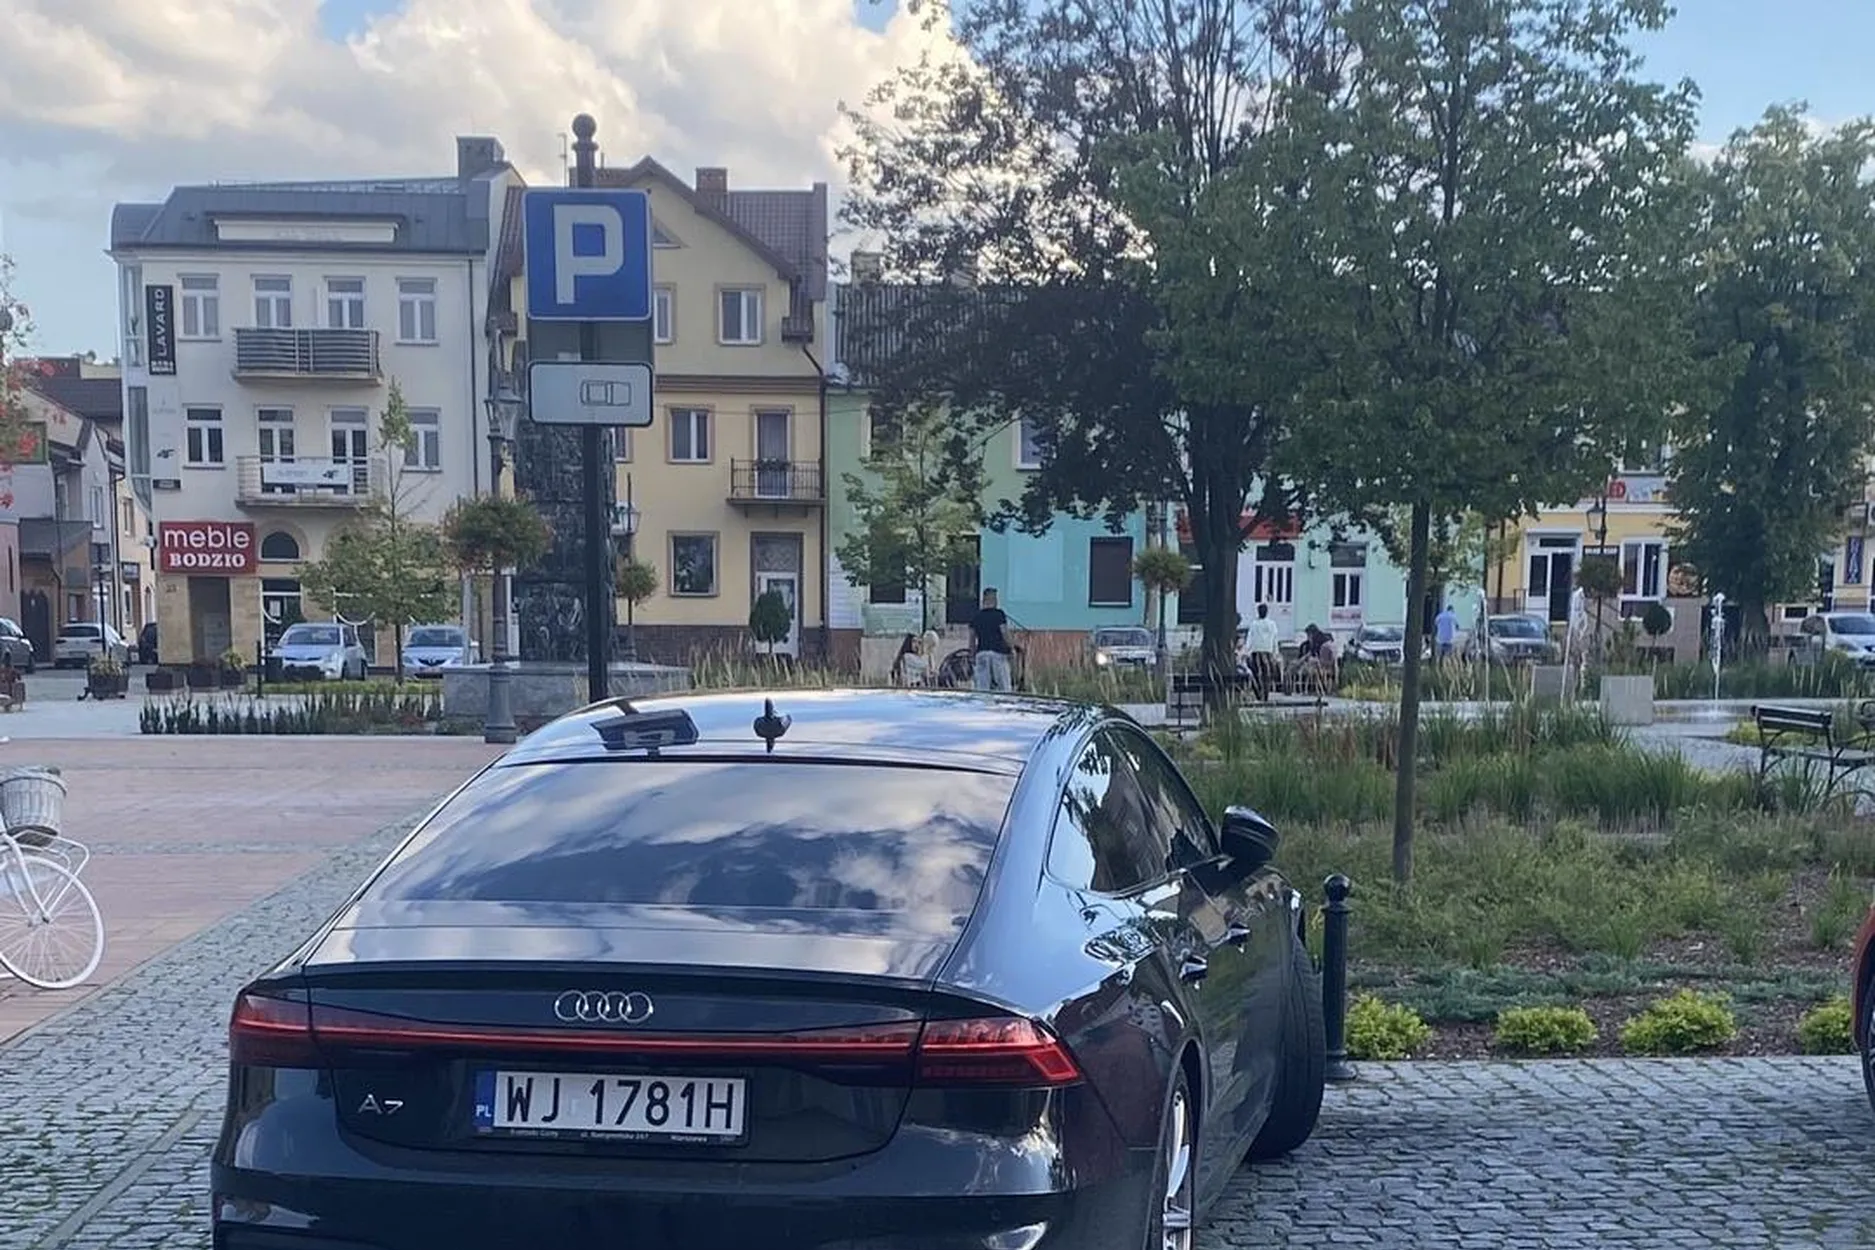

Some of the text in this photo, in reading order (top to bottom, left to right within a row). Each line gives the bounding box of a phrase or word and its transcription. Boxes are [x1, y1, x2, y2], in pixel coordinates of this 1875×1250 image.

[553, 204, 625, 305] P
[154, 288, 168, 358] LAVARD
[164, 525, 251, 549] meble
[169, 552, 247, 568] BODZIO
[358, 1093, 404, 1115] A7
[475, 1104, 492, 1118] PL
[506, 1075, 735, 1129] WJ 1781H
